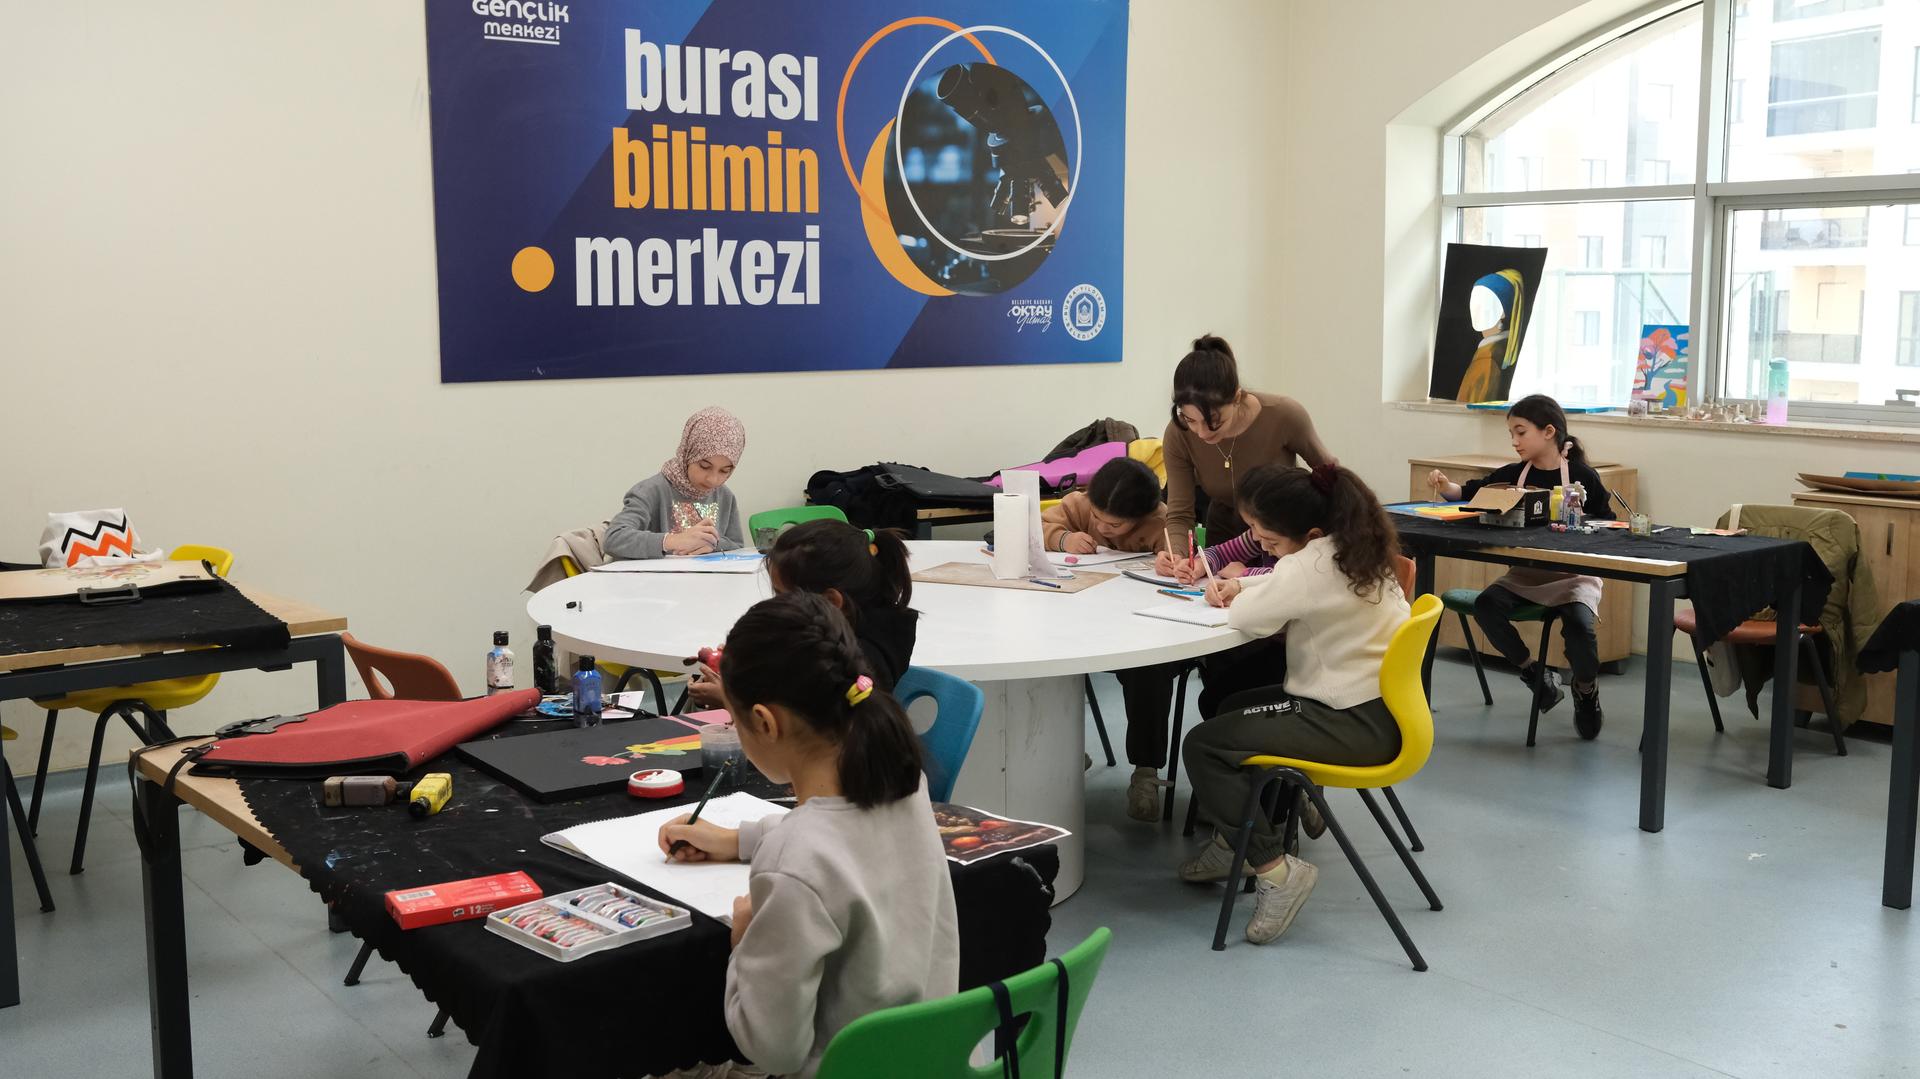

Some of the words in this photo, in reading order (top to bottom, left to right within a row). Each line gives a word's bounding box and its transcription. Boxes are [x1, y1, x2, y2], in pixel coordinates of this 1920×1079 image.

[625, 28, 818, 121] burası
[612, 124, 819, 213] bilimin
[576, 225, 820, 306] merkezi
[1011, 305, 1053, 317] OKTAY
[1243, 700, 1292, 715] ACTIVE
[469, 904, 482, 915] 12
